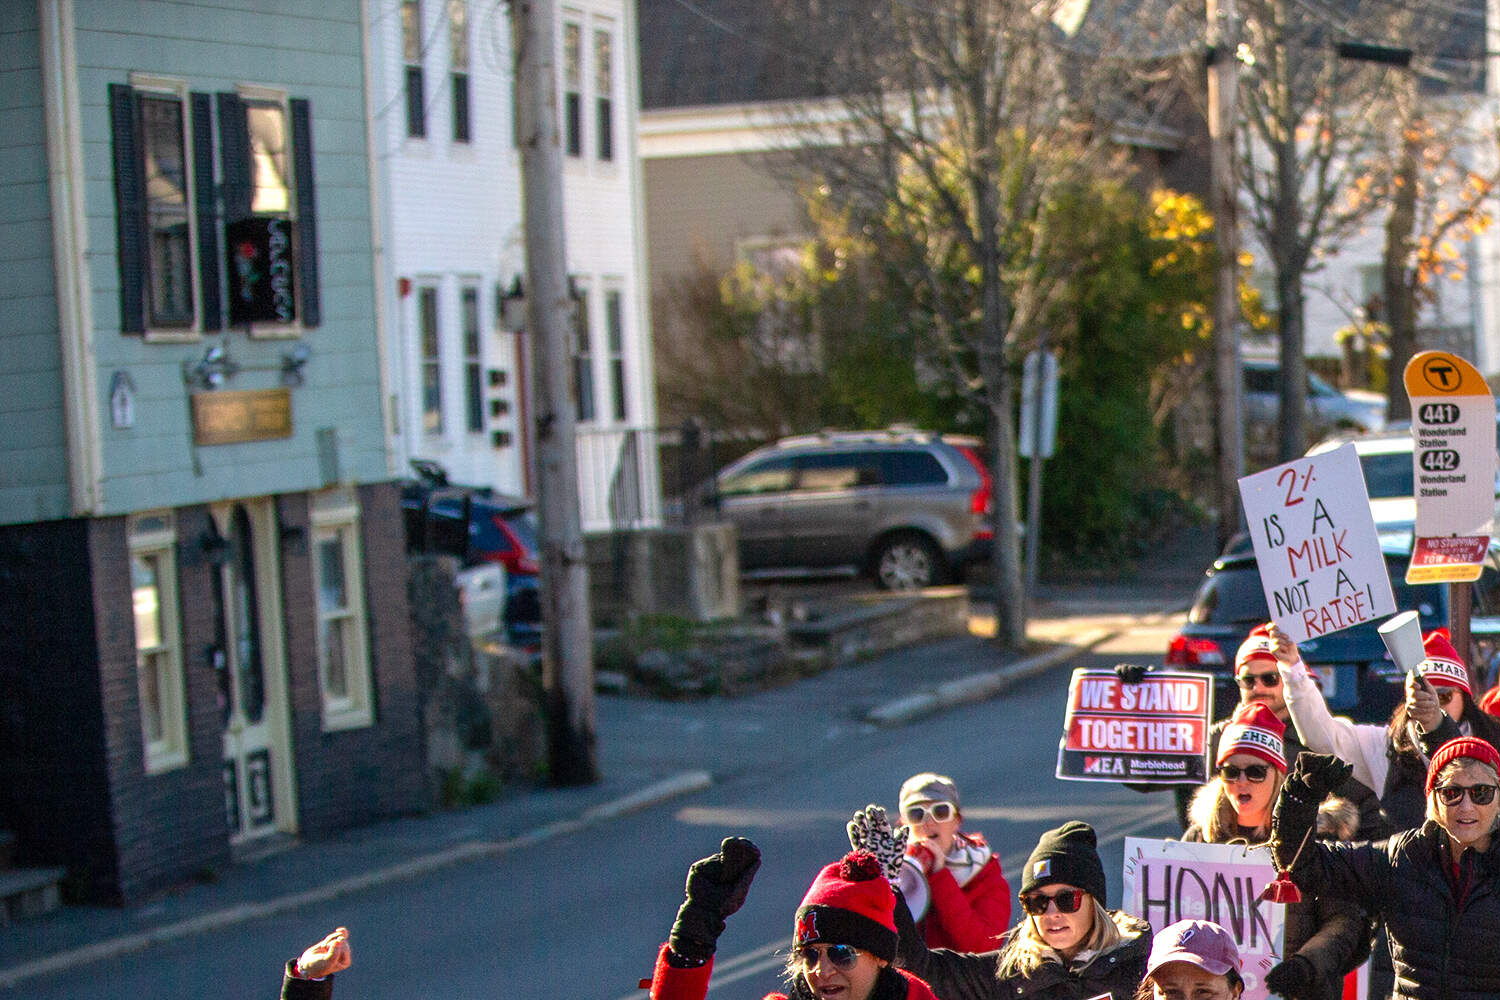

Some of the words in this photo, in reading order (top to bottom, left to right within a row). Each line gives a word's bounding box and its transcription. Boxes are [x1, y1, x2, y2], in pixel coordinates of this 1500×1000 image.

[1423, 404, 1454, 423] 441
[1419, 427, 1467, 437] Wonderland
[1419, 439, 1448, 448] Station
[1424, 451, 1455, 470] 442
[1276, 464, 1317, 508] 2%
[1420, 474, 1467, 485] Wonderland
[1420, 488, 1448, 497] Station
[1263, 513, 1285, 549] IS
[1312, 498, 1335, 535] A
[1287, 528, 1353, 578] MILK
[1273, 579, 1311, 618] NOT
[1335, 567, 1357, 597] A
[1302, 583, 1377, 638] RAISE!
[1081, 680, 1116, 709] WE
[1120, 682, 1199, 712] STAND
[1077, 719, 1194, 751] TOGETHER
[1084, 756, 1125, 775] MEA
[1142, 864, 1280, 960] HONK
